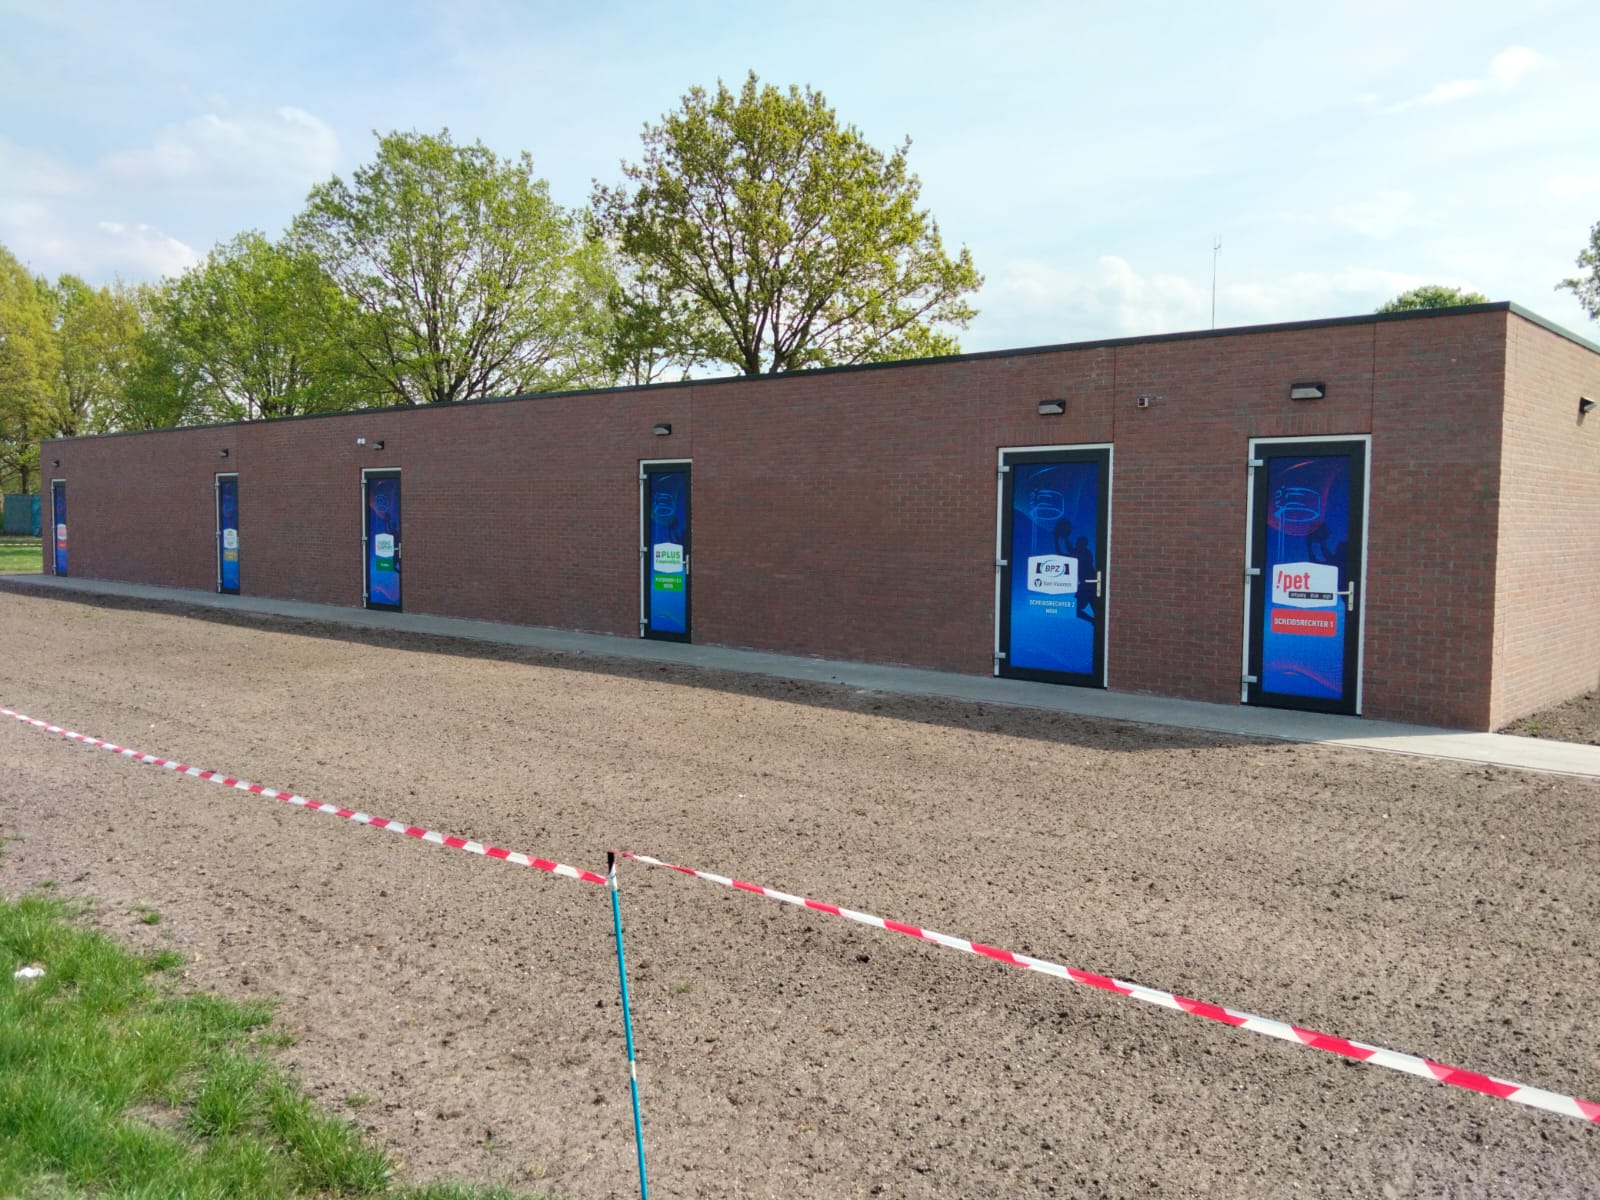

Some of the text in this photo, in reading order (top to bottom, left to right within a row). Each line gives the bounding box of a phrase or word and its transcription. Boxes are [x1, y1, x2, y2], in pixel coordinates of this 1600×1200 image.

[661, 551, 681, 559] PLUS
[1045, 564, 1061, 573] BPZ
[1273, 617, 1329, 628] SCHEIDSRECHTER
